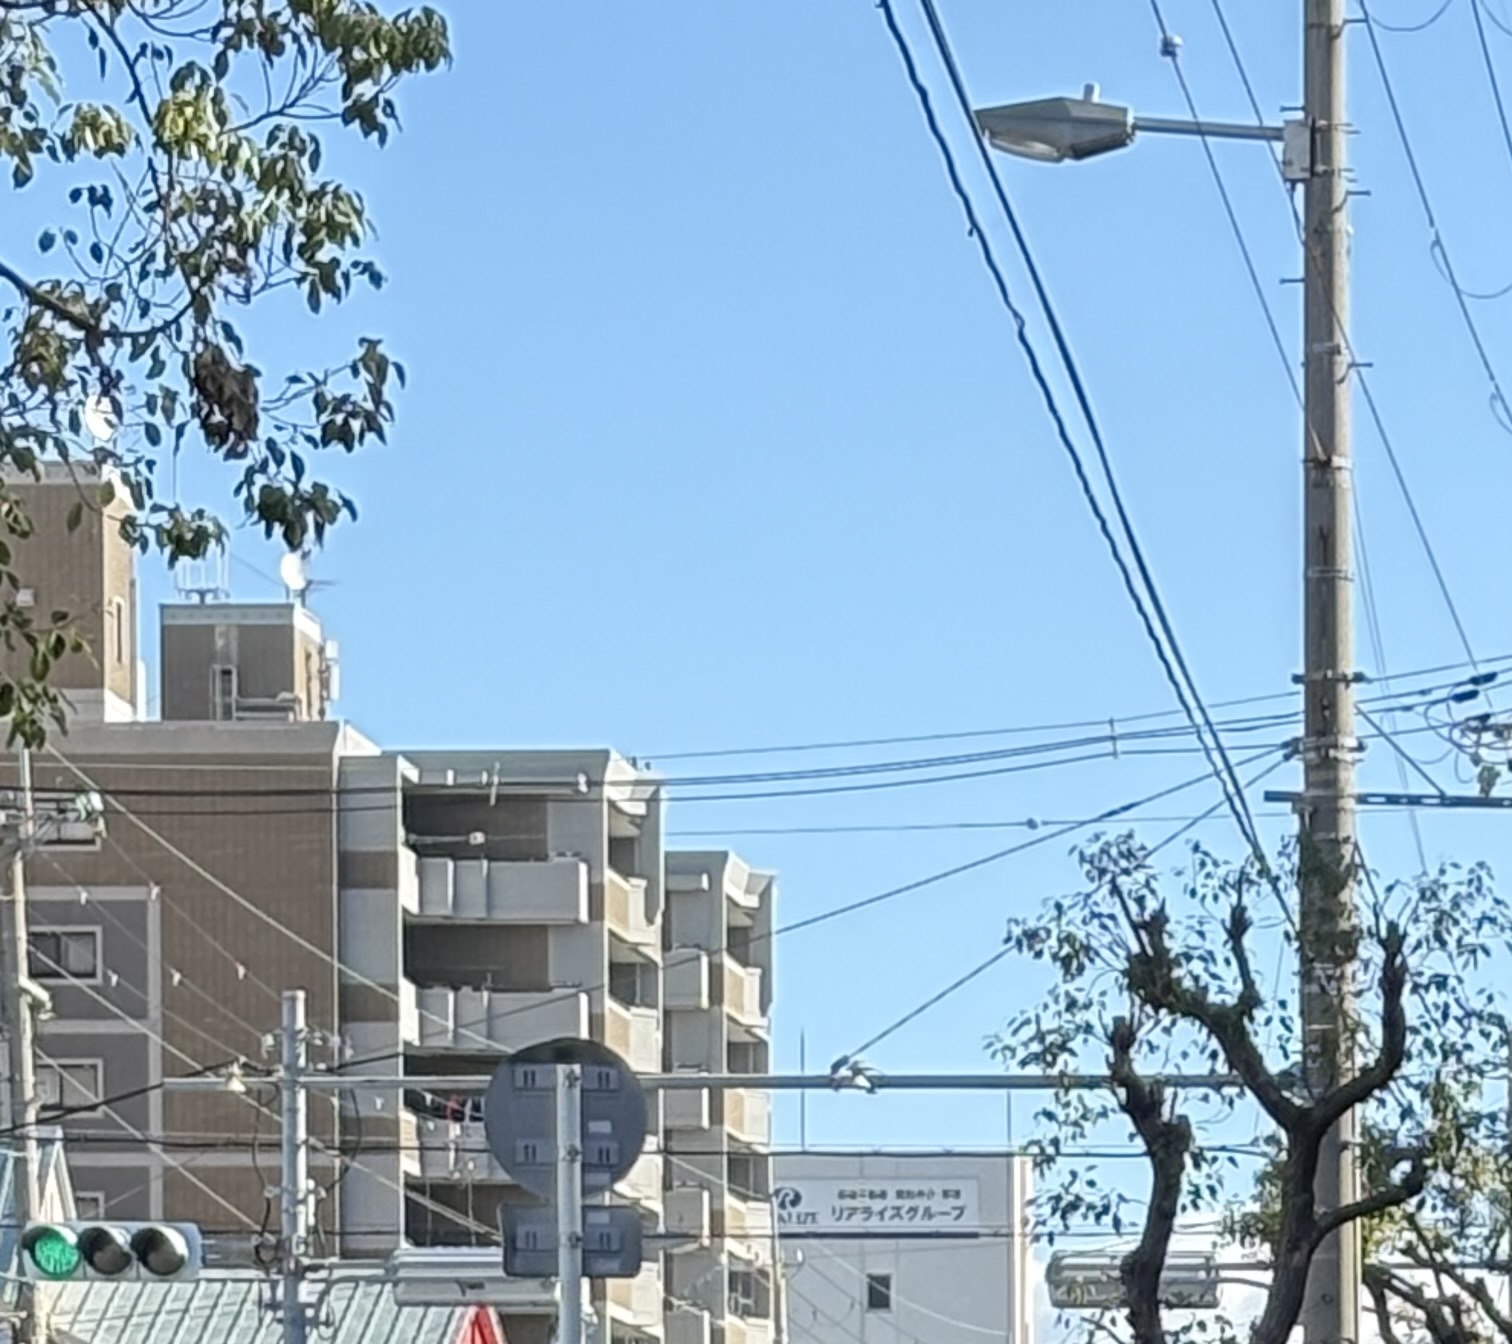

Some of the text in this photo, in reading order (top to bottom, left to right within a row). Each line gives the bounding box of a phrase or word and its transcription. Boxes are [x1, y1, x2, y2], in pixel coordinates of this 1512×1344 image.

[832, 1205, 966, 1222] リアライズグループ
